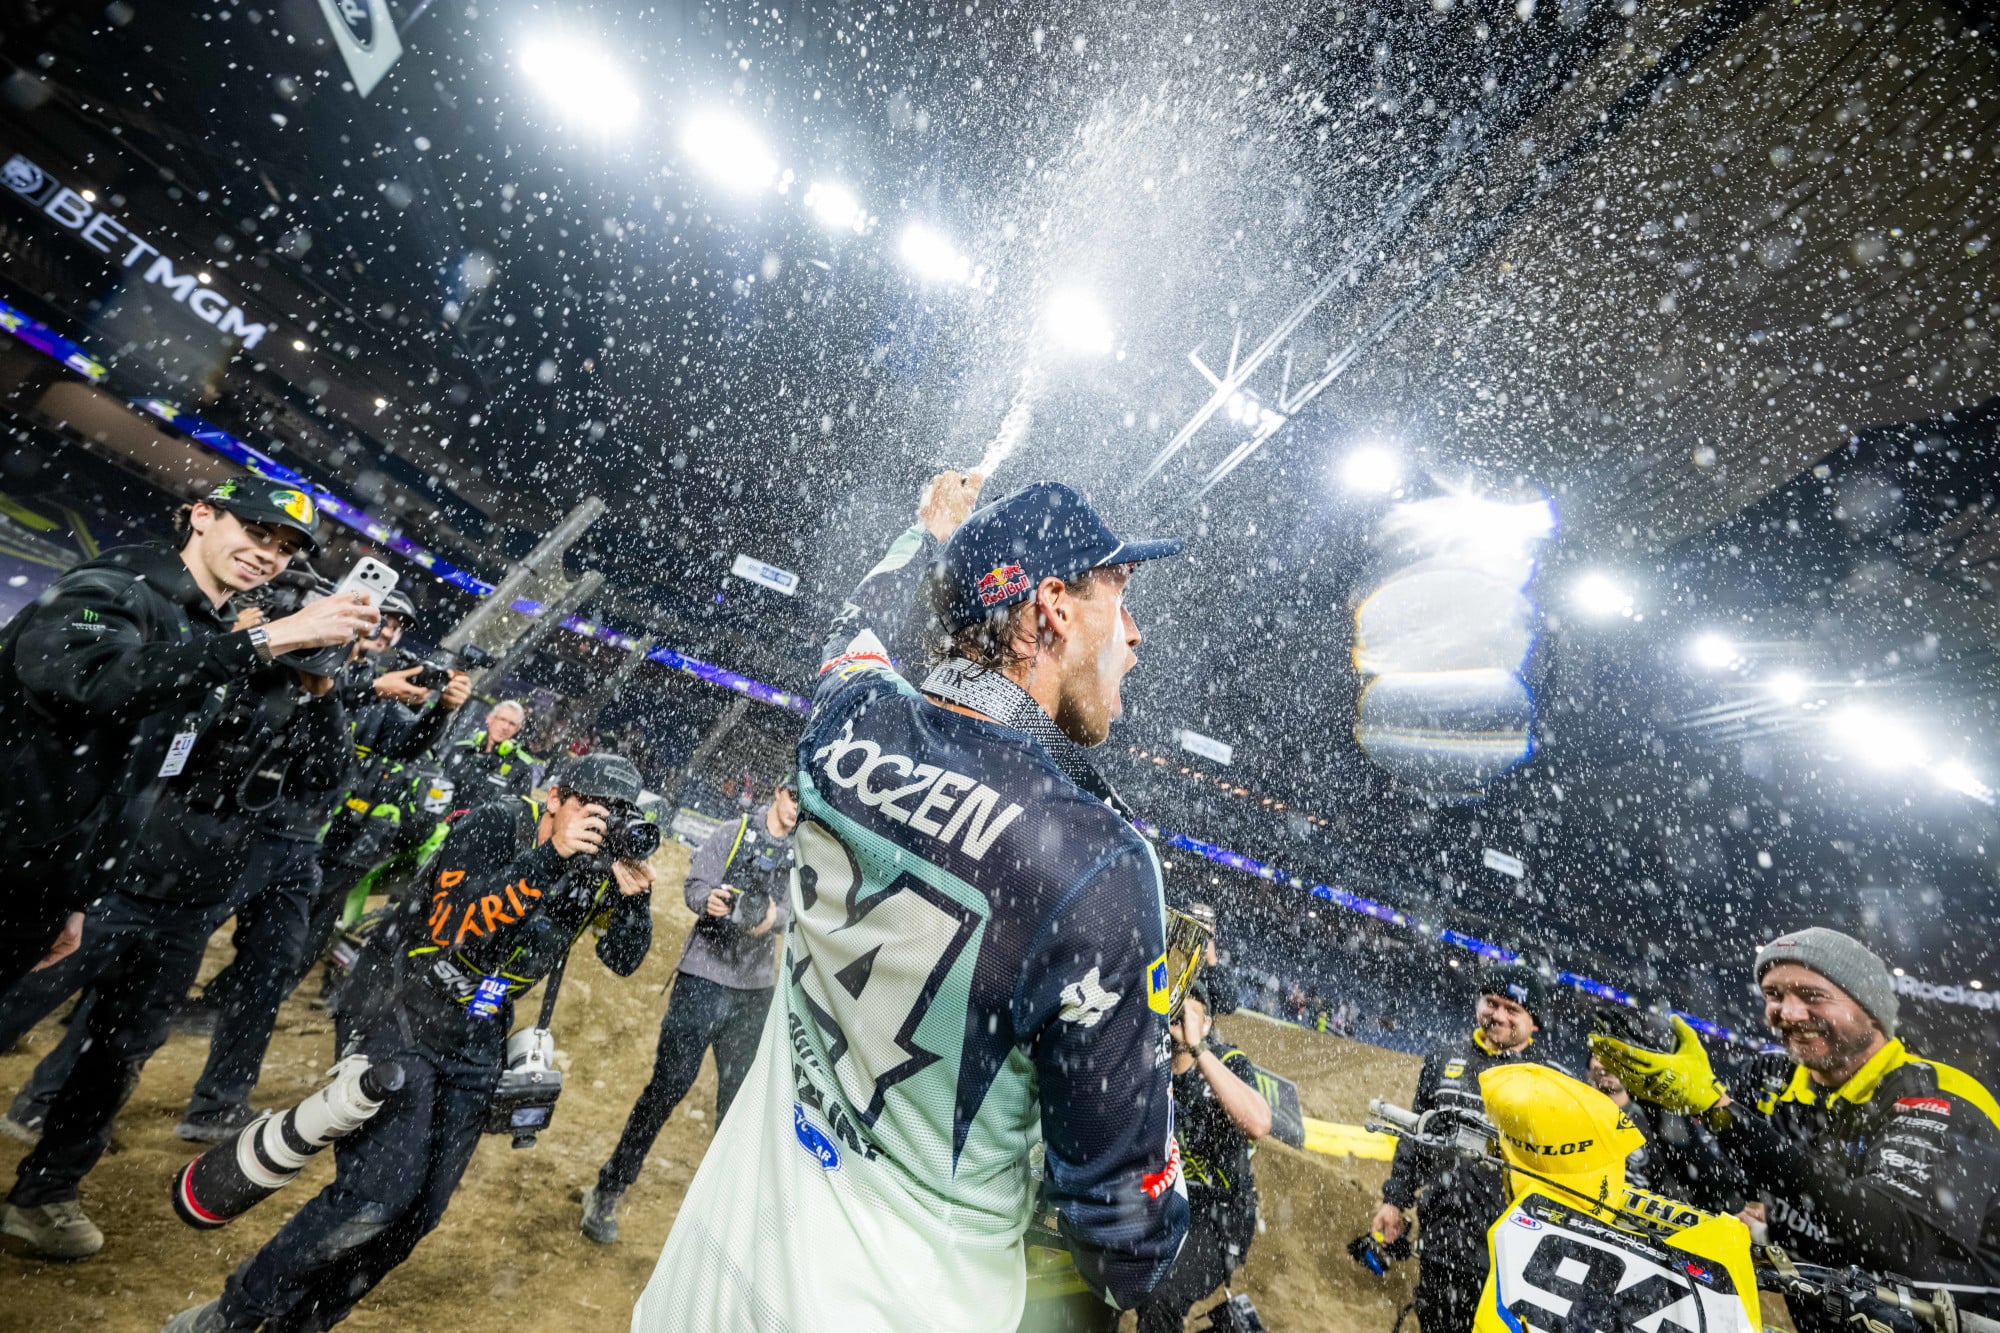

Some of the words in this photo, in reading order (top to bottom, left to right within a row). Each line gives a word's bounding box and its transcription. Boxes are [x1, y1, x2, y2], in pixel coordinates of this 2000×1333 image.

[44, 186, 267, 350] BETMGM
[980, 586, 1008, 606] Red
[1005, 574, 1031, 595] Bull
[1568, 1218, 1669, 1261] SUPERCROSS
[1507, 1233, 1693, 1333] 94
